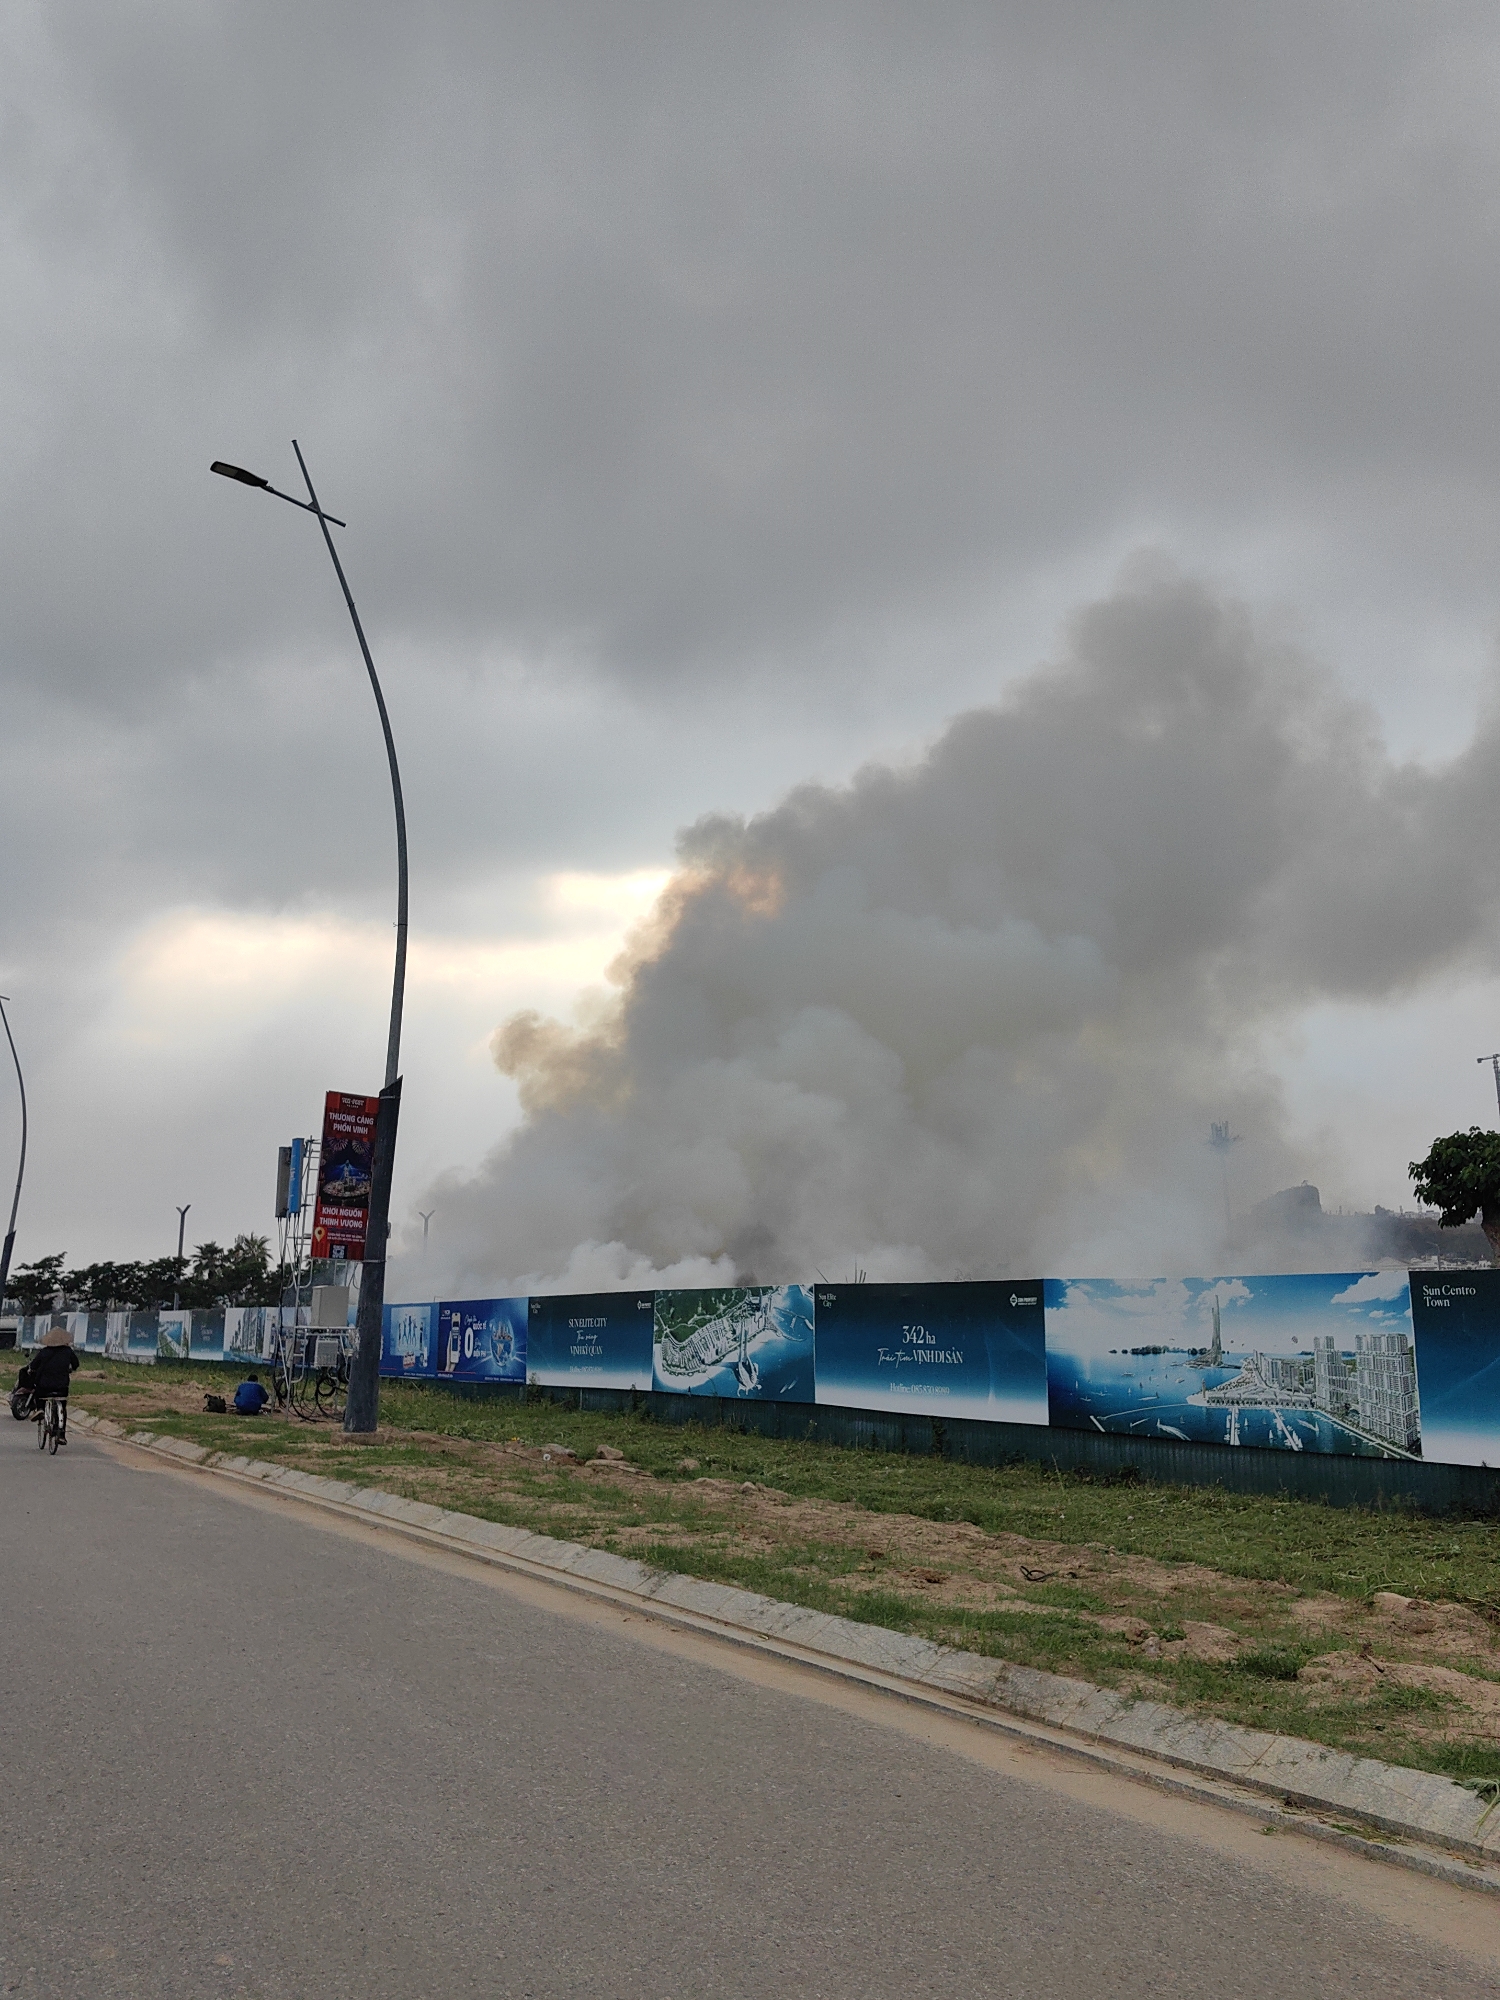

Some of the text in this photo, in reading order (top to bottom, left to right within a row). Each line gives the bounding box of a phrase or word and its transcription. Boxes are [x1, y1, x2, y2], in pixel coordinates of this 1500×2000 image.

[352, 1125, 369, 1134] VINH
[1422, 1284, 1477, 1296] Sun Centro
[1423, 1296, 1451, 1307] Town
[902, 1325, 937, 1345] 342 ha
[913, 1349, 935, 1365] VỊNH
[935, 1350, 945, 1364] DI
[945, 1346, 964, 1364] SẢN
